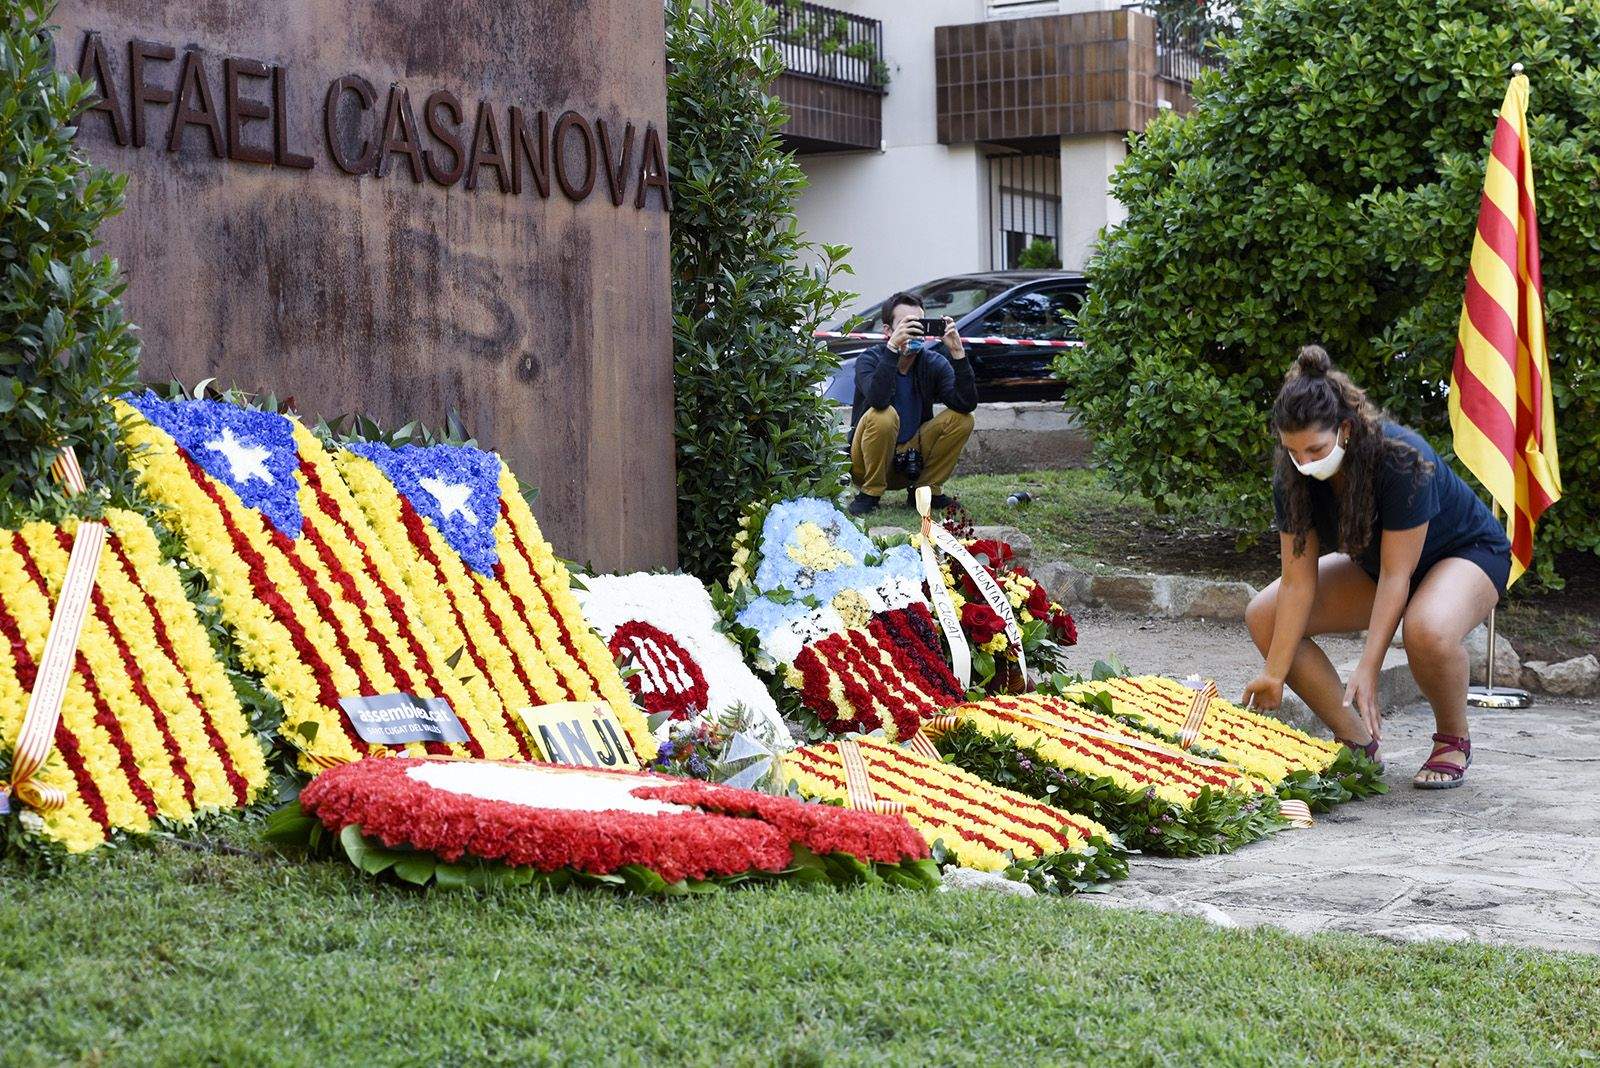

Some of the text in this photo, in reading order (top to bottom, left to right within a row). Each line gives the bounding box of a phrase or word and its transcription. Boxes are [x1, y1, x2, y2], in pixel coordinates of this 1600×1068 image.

[40, 27, 671, 212] AFAEL CASANOVA
[971, 565, 1020, 642] MUNTANYEN
[358, 702, 452, 723] assemblea.cat
[384, 725, 409, 736] CUGAT
[408, 723, 424, 734] DEL
